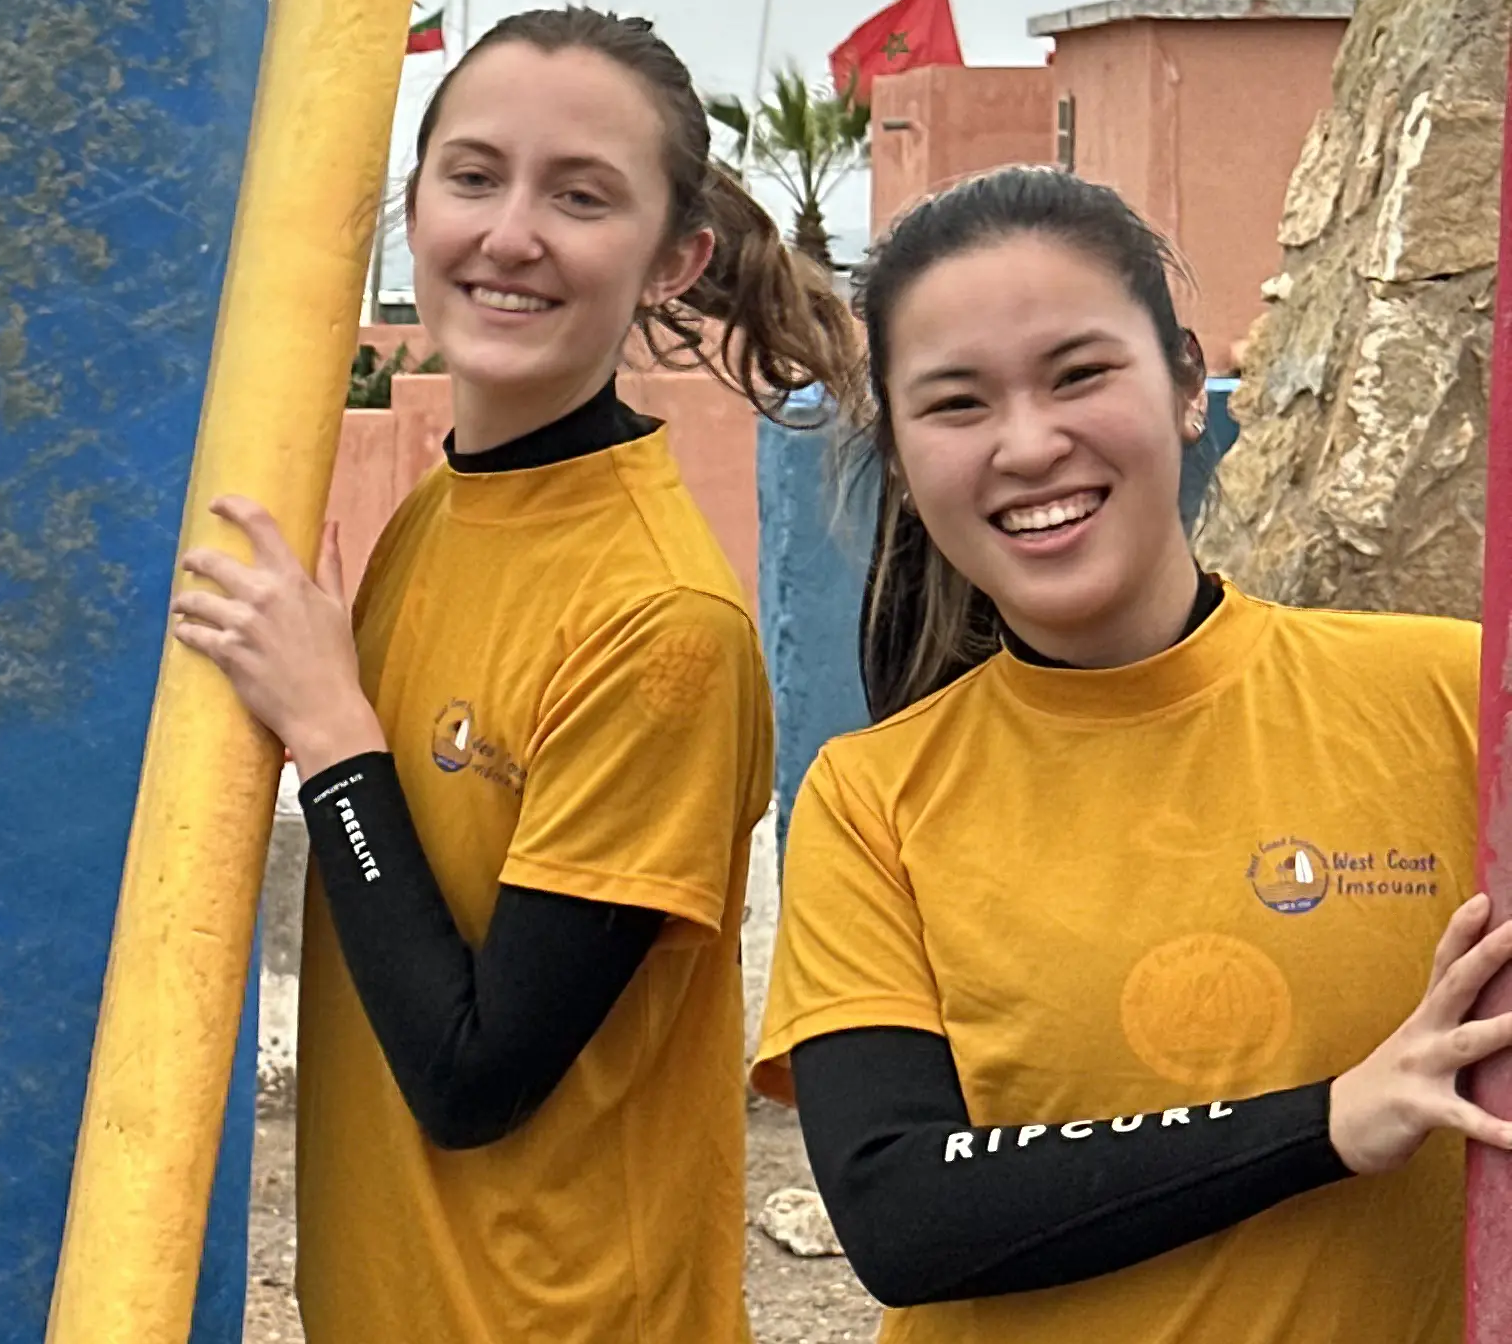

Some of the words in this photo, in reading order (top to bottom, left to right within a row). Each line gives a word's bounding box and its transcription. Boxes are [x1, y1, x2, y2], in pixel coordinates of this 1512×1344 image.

[334, 796, 381, 883] FREELITE
[1332, 851, 1375, 872] West
[1387, 848, 1437, 872] Coast
[1337, 874, 1439, 898] Imsouane
[944, 1100, 1233, 1162] RIPCURL
